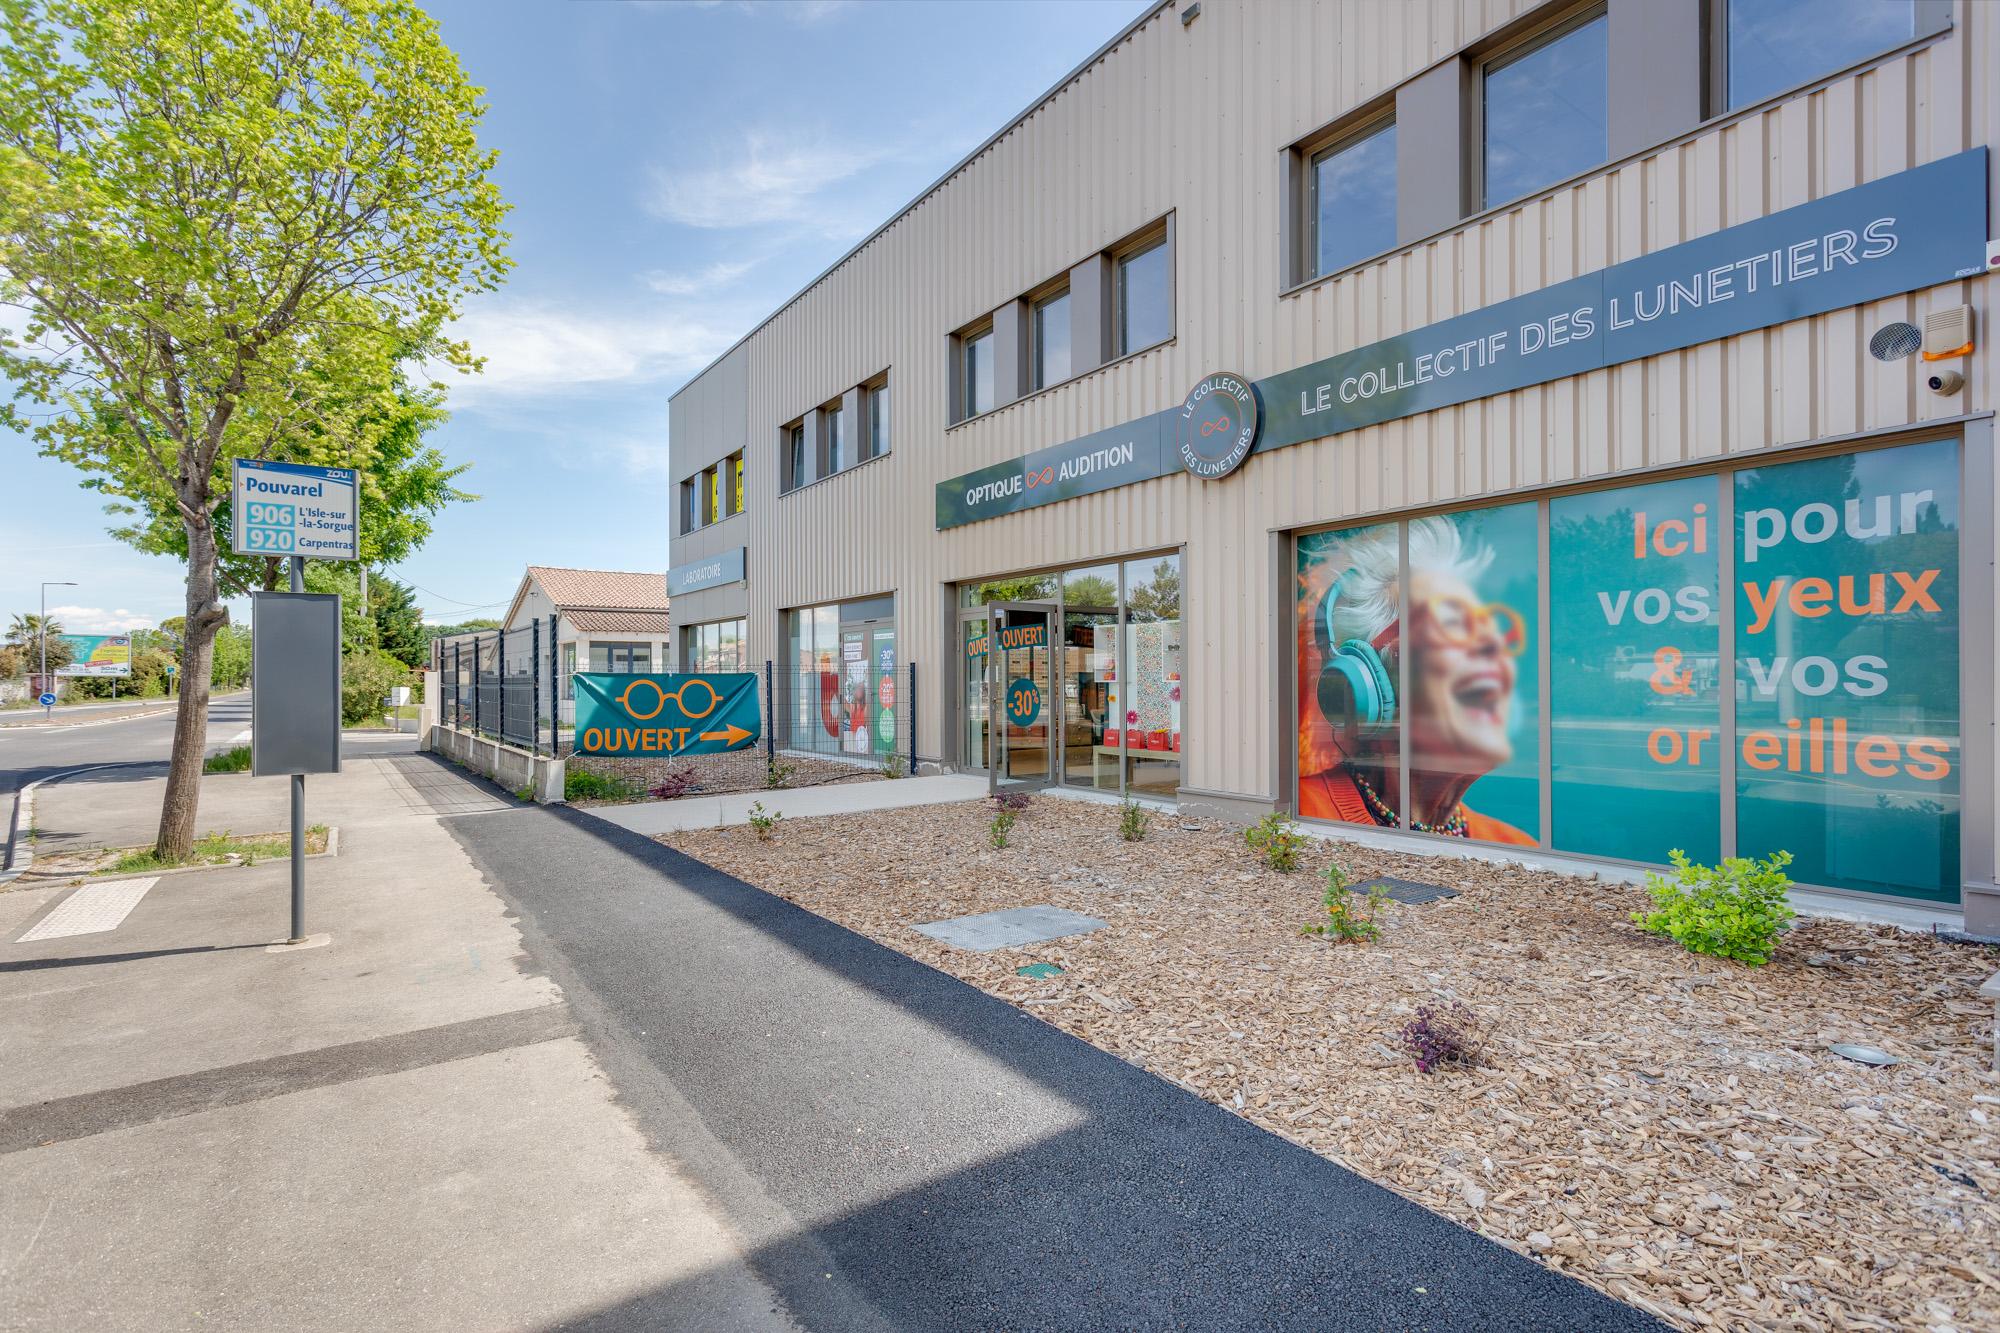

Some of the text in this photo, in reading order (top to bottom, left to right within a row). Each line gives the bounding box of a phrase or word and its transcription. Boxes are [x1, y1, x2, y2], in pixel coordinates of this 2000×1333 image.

[1301, 217, 1899, 416] LE COLLECTIF DES LUNETIERS
[1183, 378, 1249, 418] LE COLLECTIF
[1181, 427, 1251, 475] DES LUNETIERS
[966, 442, 1133, 506] OPTIQUE AUDITION
[246, 477, 323, 497] Pouvarel
[250, 504, 292, 525] 906
[299, 507, 346, 520] L'Isle-sur
[299, 518, 353, 533] -la-Sorgue
[1634, 489, 1933, 562] Ici pour
[250, 530, 293, 550] 920
[299, 537, 354, 550] Carpentras
[682, 562, 721, 585] LABORATOIRE
[1597, 569, 1943, 634] vos yeux
[968, 637, 988, 656] OUVE
[1002, 626, 1043, 648] OUVERT
[1650, 646, 1889, 697] & vos
[1008, 689, 1039, 717] -30%
[584, 727, 691, 751] OUVERT
